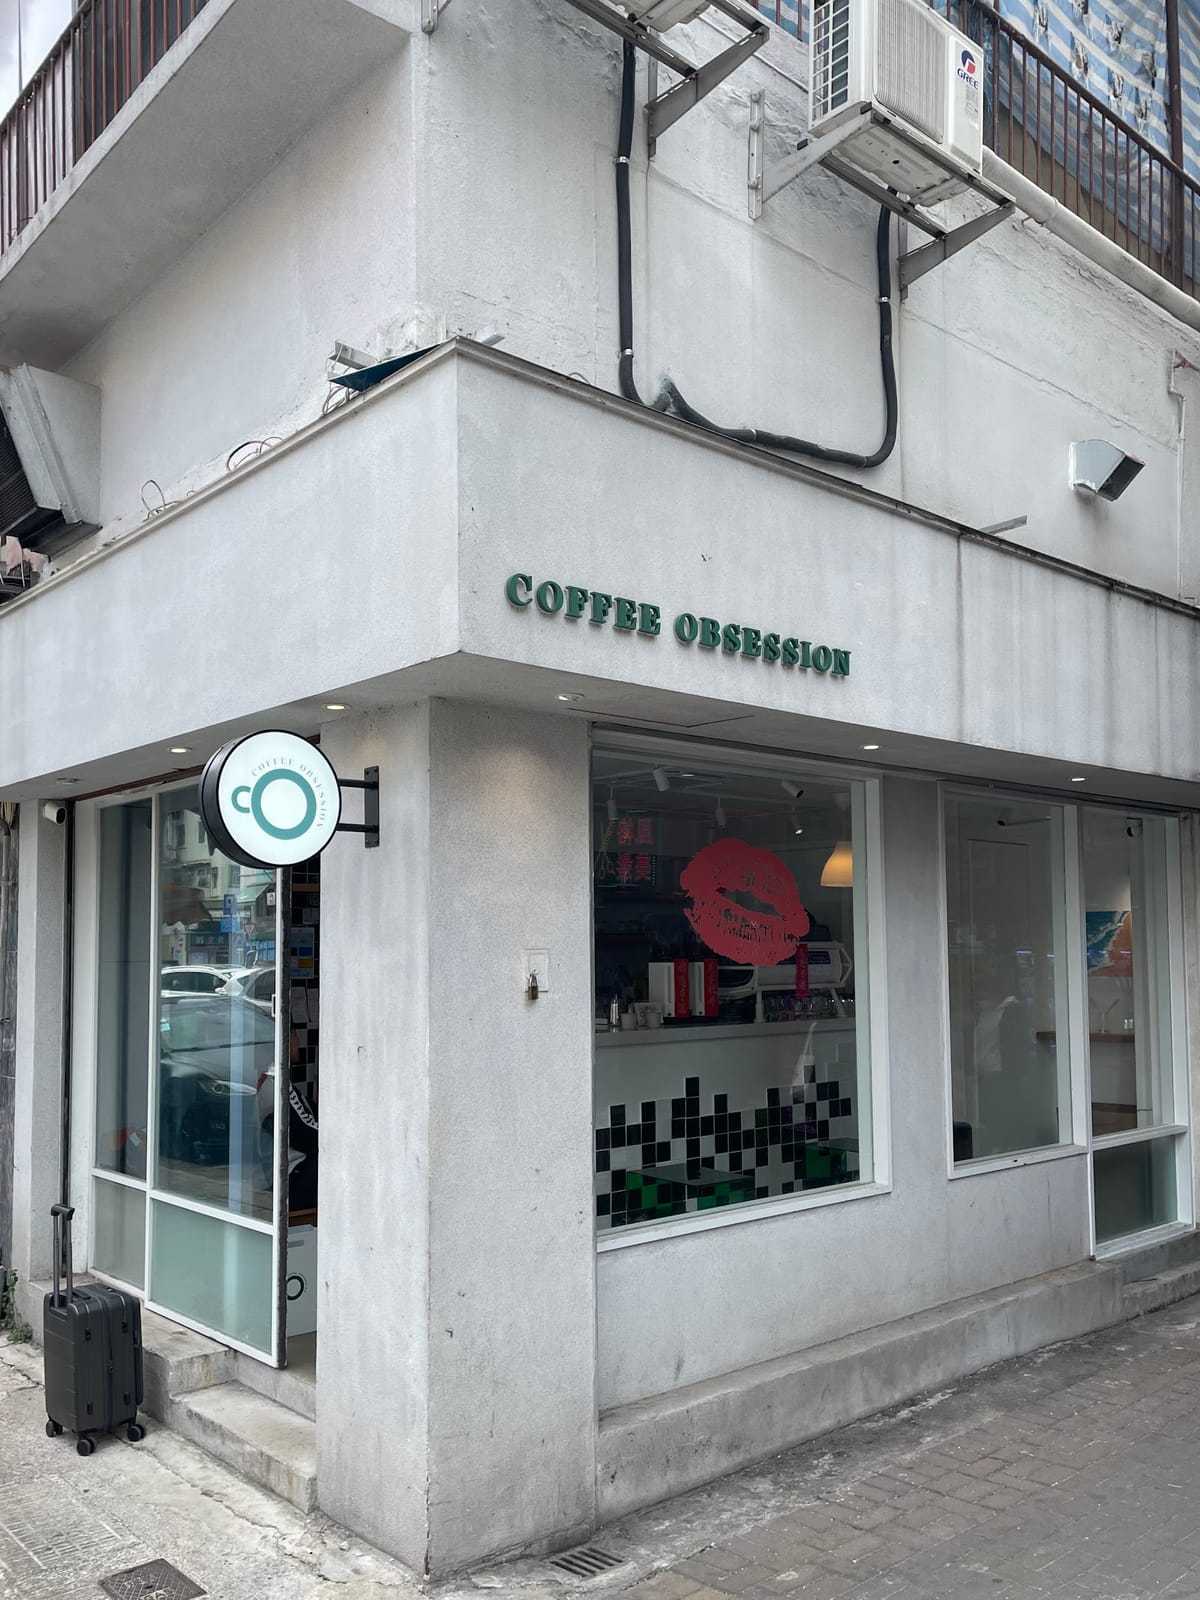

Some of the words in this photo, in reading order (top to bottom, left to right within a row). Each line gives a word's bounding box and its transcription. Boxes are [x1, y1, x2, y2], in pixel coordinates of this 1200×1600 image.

[957, 68, 979, 89] GREE
[505, 572, 662, 636] COFFEE
[674, 612, 852, 677] OBSESSION
[251, 757, 295, 777] COFFEE
[299, 764, 328, 827] OBSESSION
